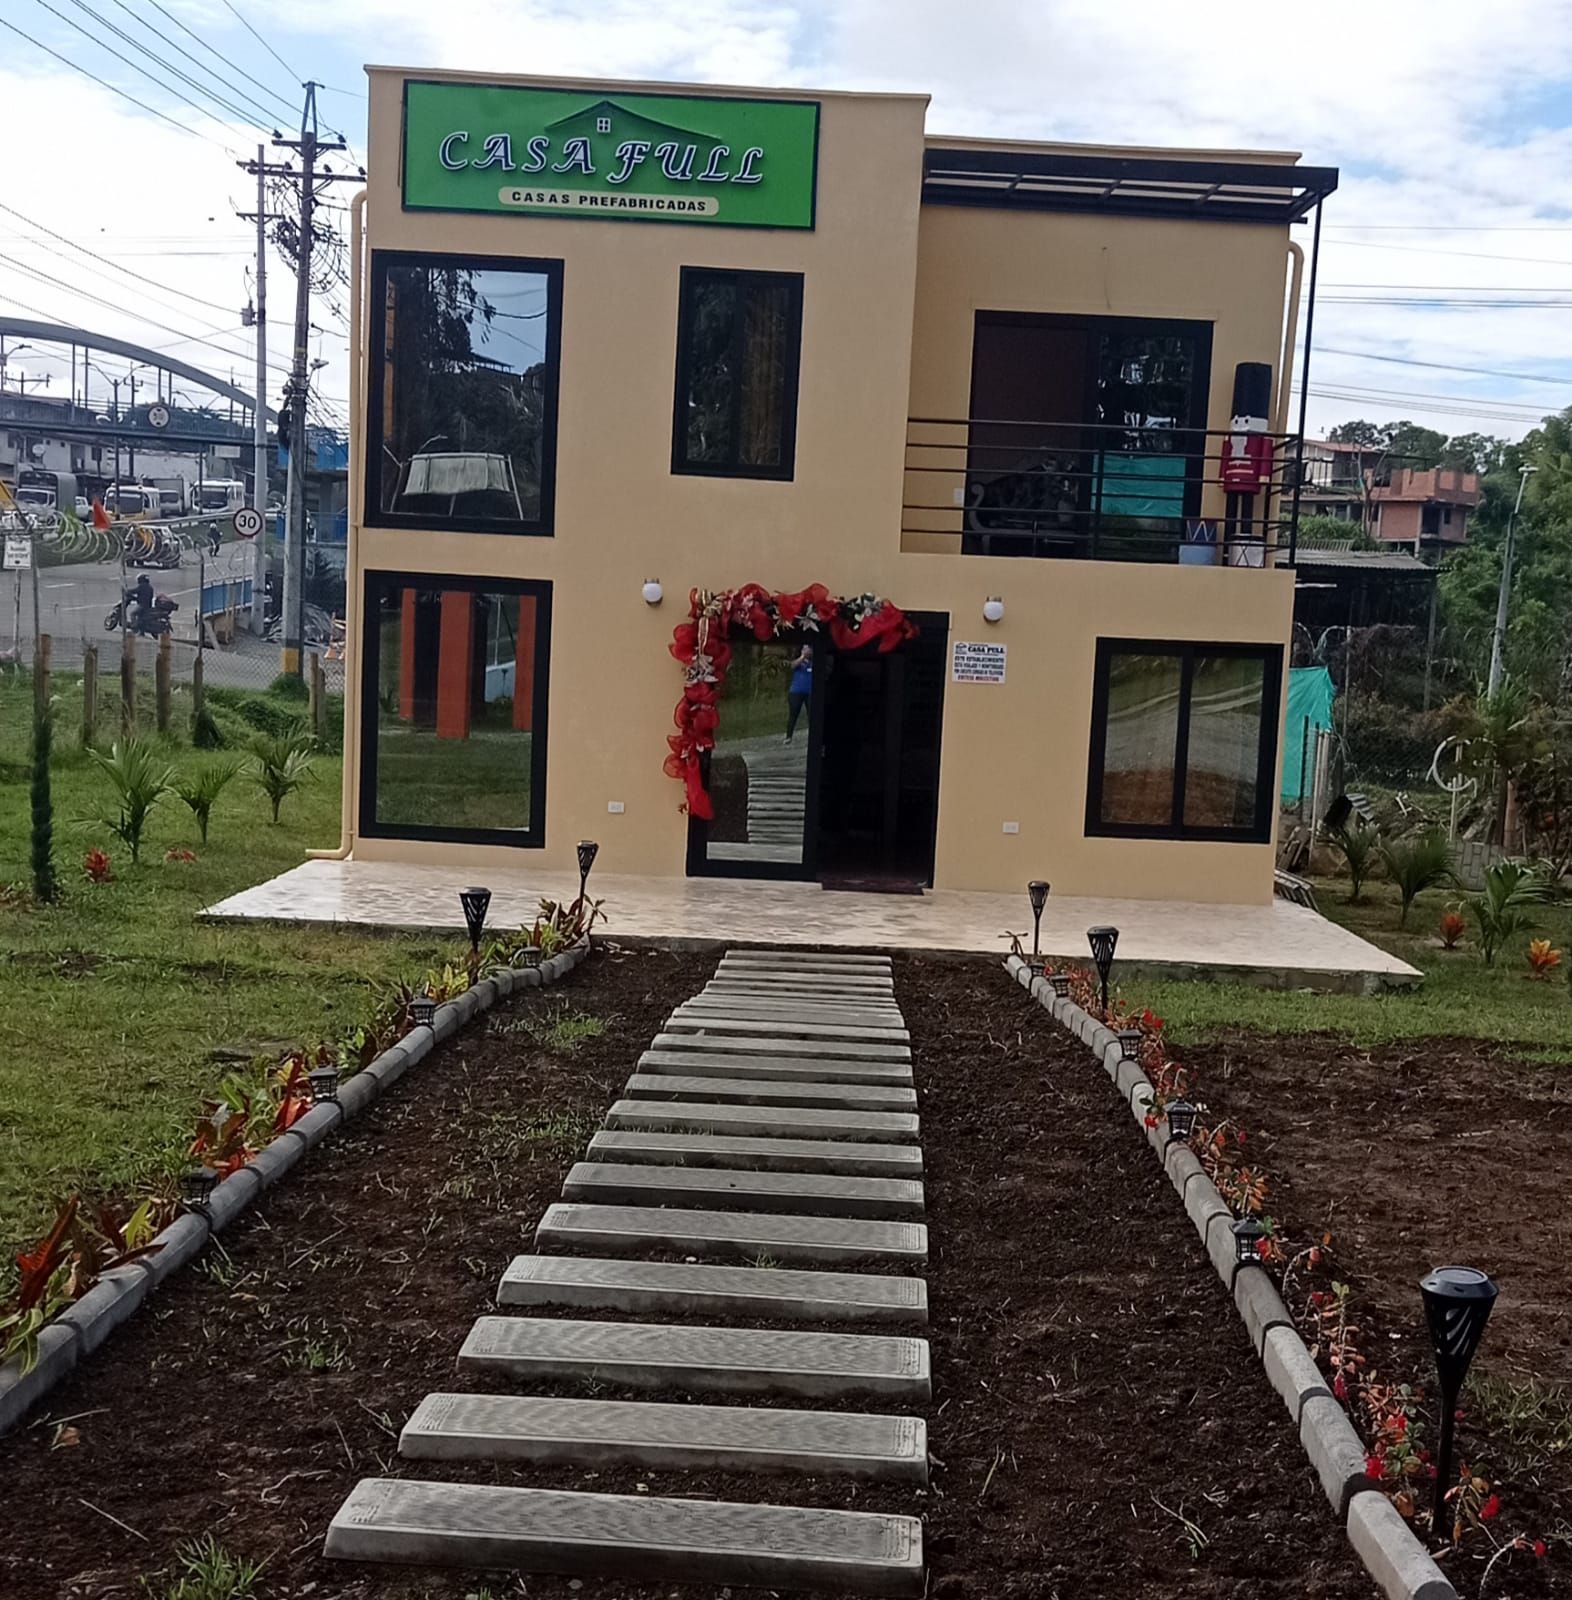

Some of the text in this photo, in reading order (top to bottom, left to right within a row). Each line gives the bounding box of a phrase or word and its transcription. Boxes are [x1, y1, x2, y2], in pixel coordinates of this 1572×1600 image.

[439, 131, 765, 185] CASA FULL
[511, 190, 707, 212] CASAS PREFABRICADAS
[238, 514, 257, 529] 30
